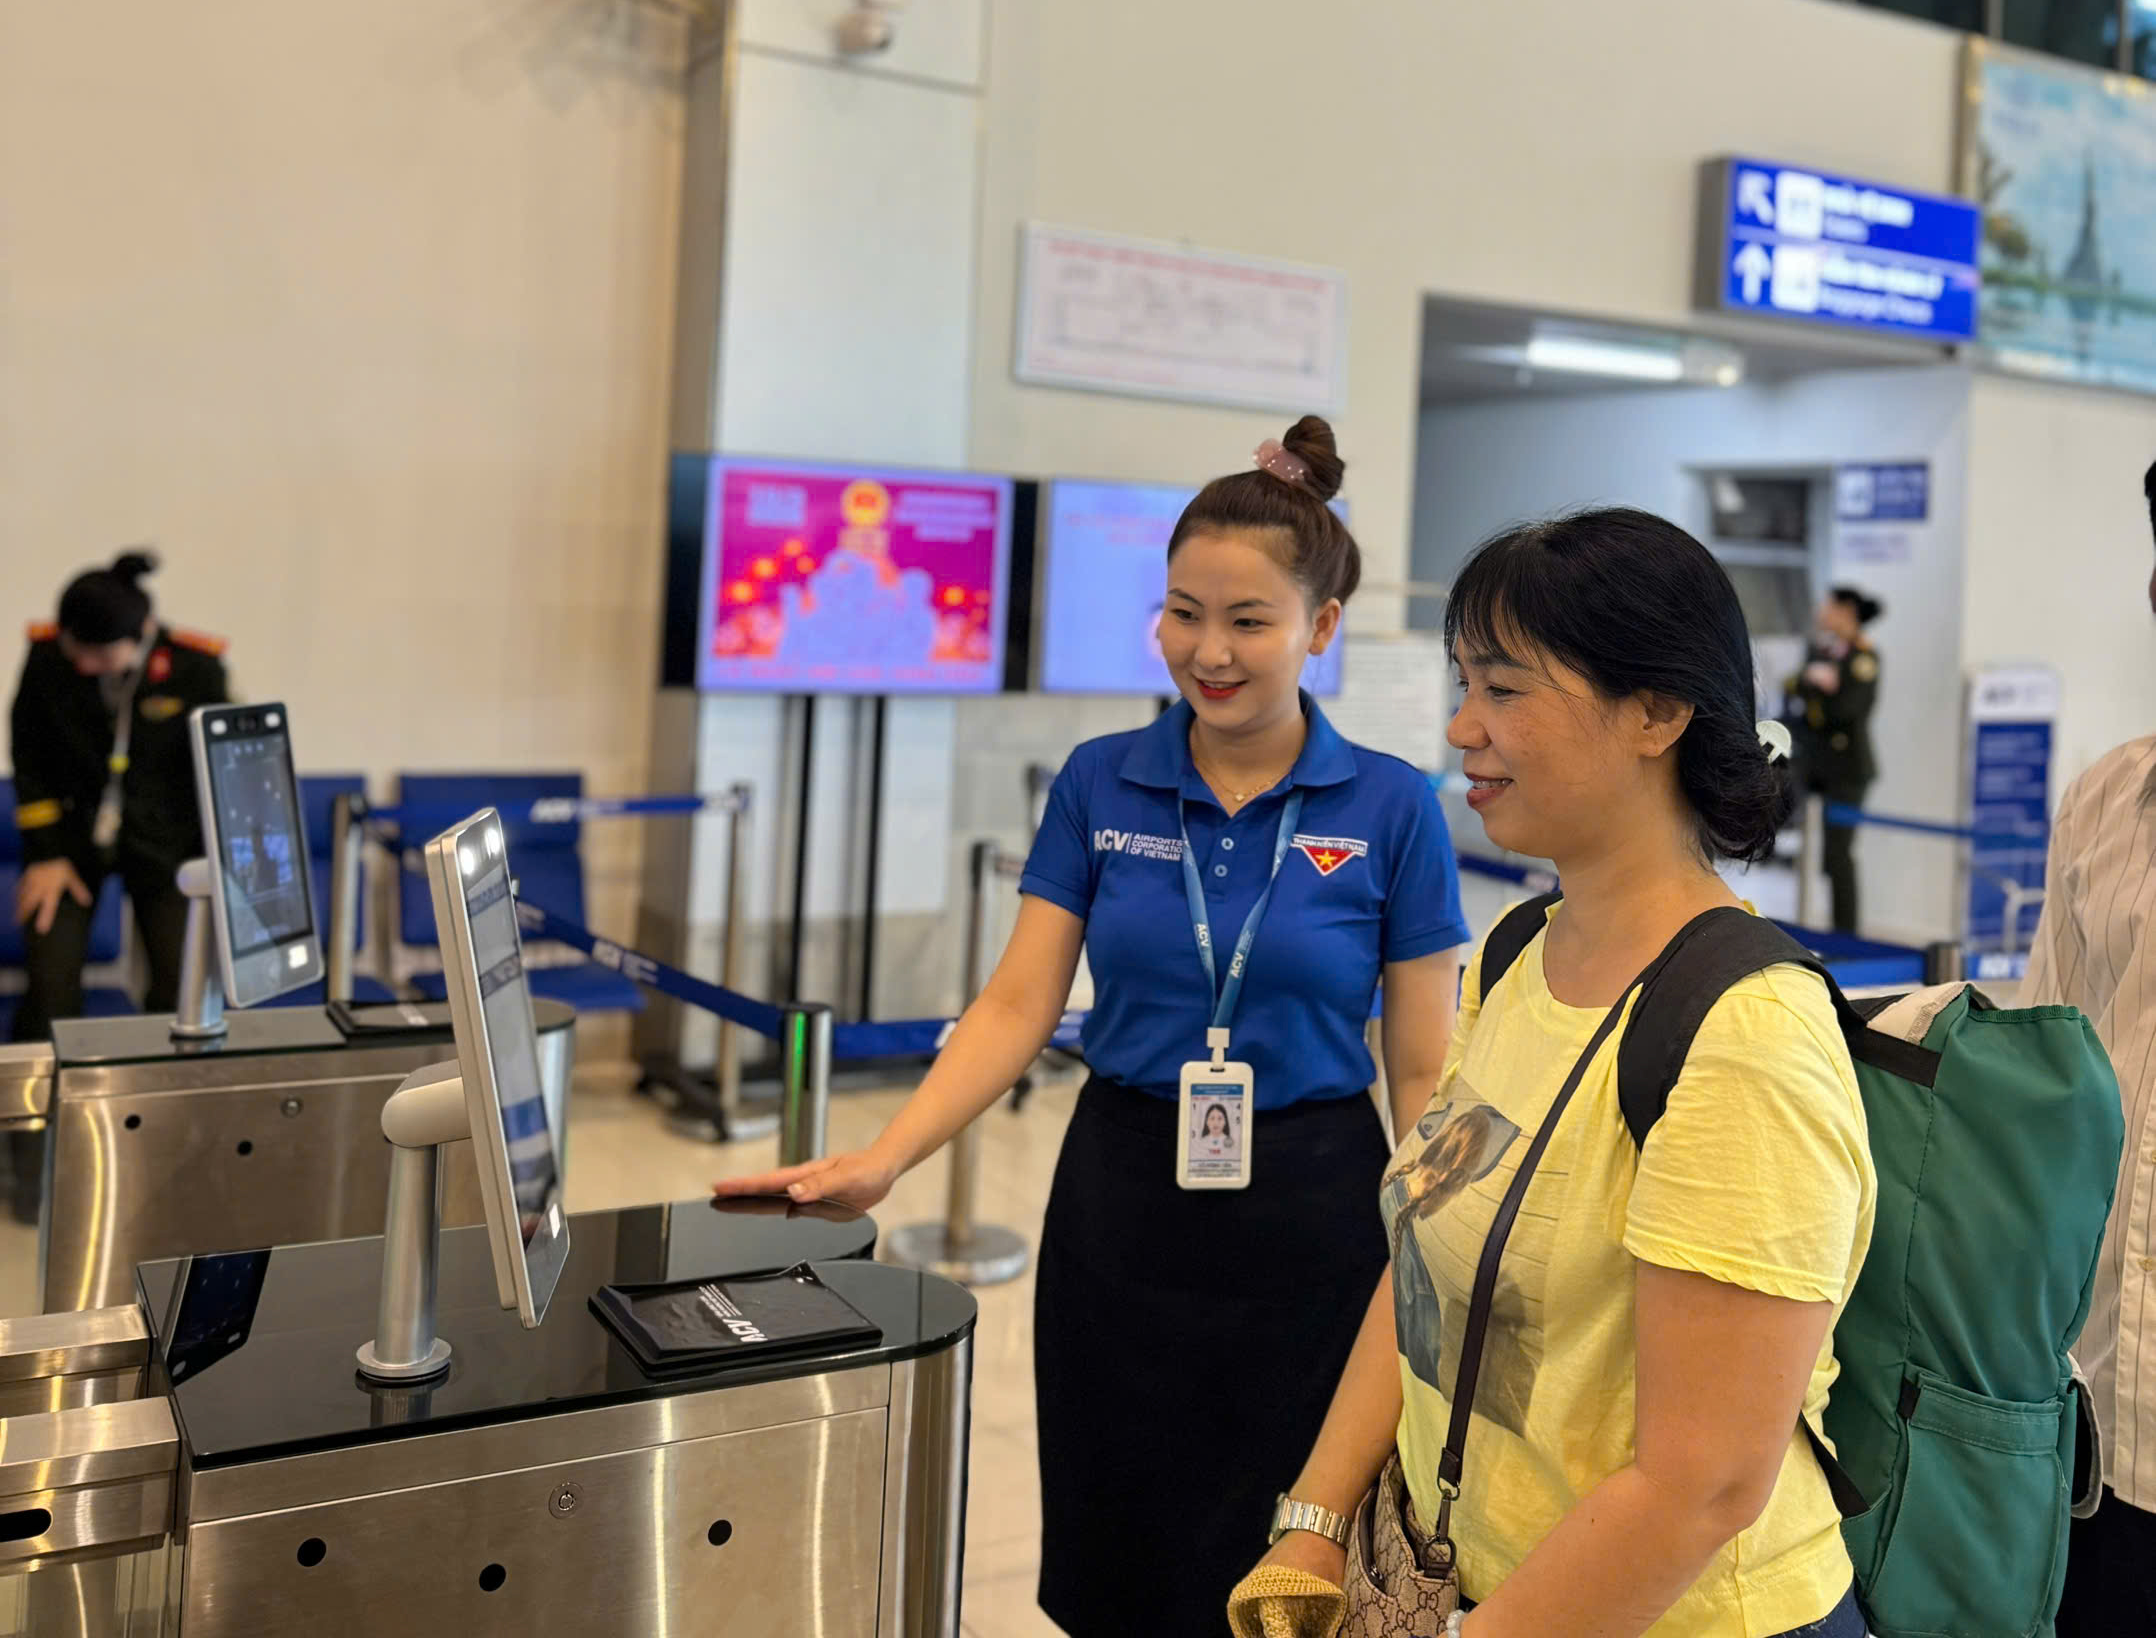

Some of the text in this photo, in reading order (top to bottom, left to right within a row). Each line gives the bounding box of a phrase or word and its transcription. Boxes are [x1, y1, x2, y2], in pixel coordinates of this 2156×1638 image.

[1131, 840, 1183, 853] CORPORATIO
[1134, 833, 1183, 847] AIRPORTS
[1130, 847, 1181, 861] OF VIETNAM
[1197, 923, 1209, 947] ACV
[1231, 952, 1244, 978] ACV
[722, 1318, 769, 1342] ACV
